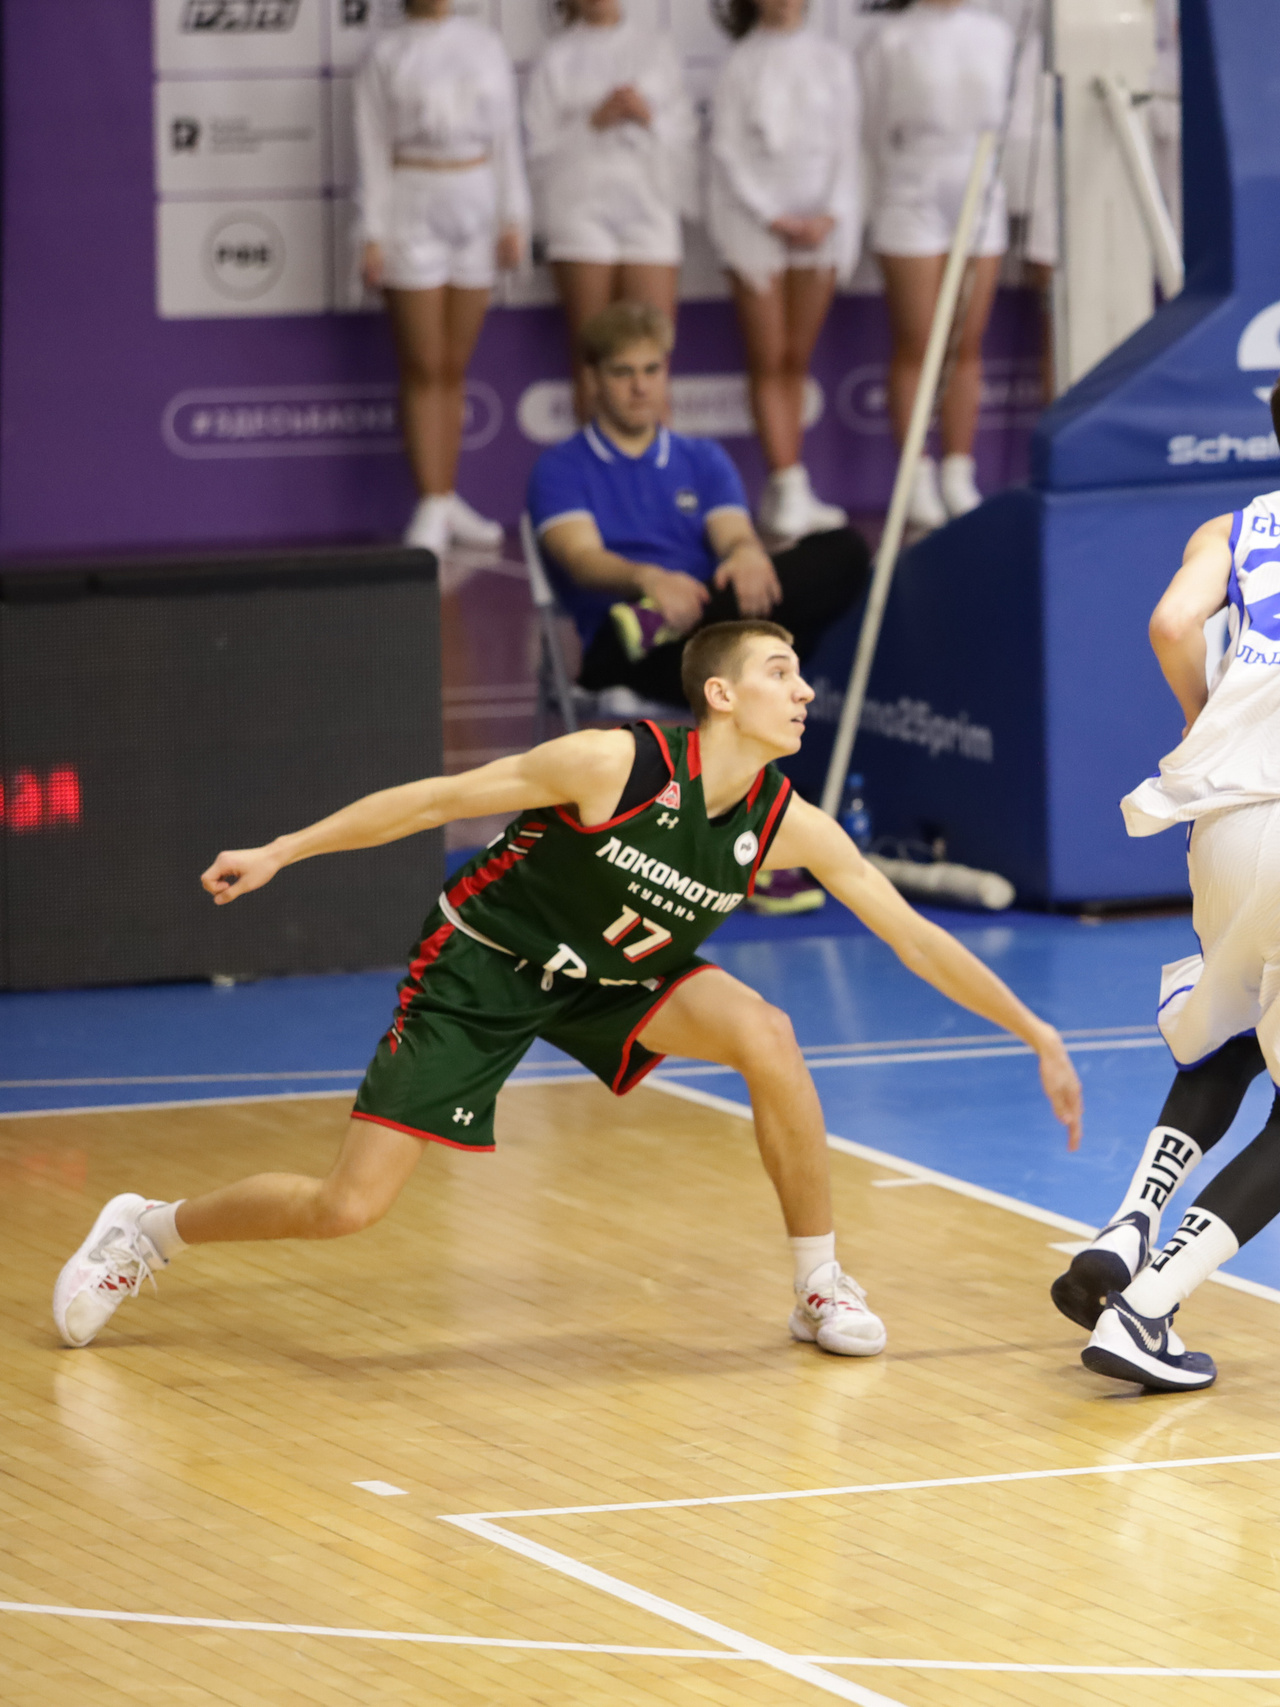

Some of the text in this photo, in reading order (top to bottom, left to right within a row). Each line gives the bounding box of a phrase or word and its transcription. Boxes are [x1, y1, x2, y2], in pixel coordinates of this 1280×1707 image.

[595, 836, 745, 913] ЛОКОМОТИВ
[627, 881, 696, 922] КУБАНЬ
[602, 904, 673, 963] 17
[1140, 1133, 1194, 1212] ELITE
